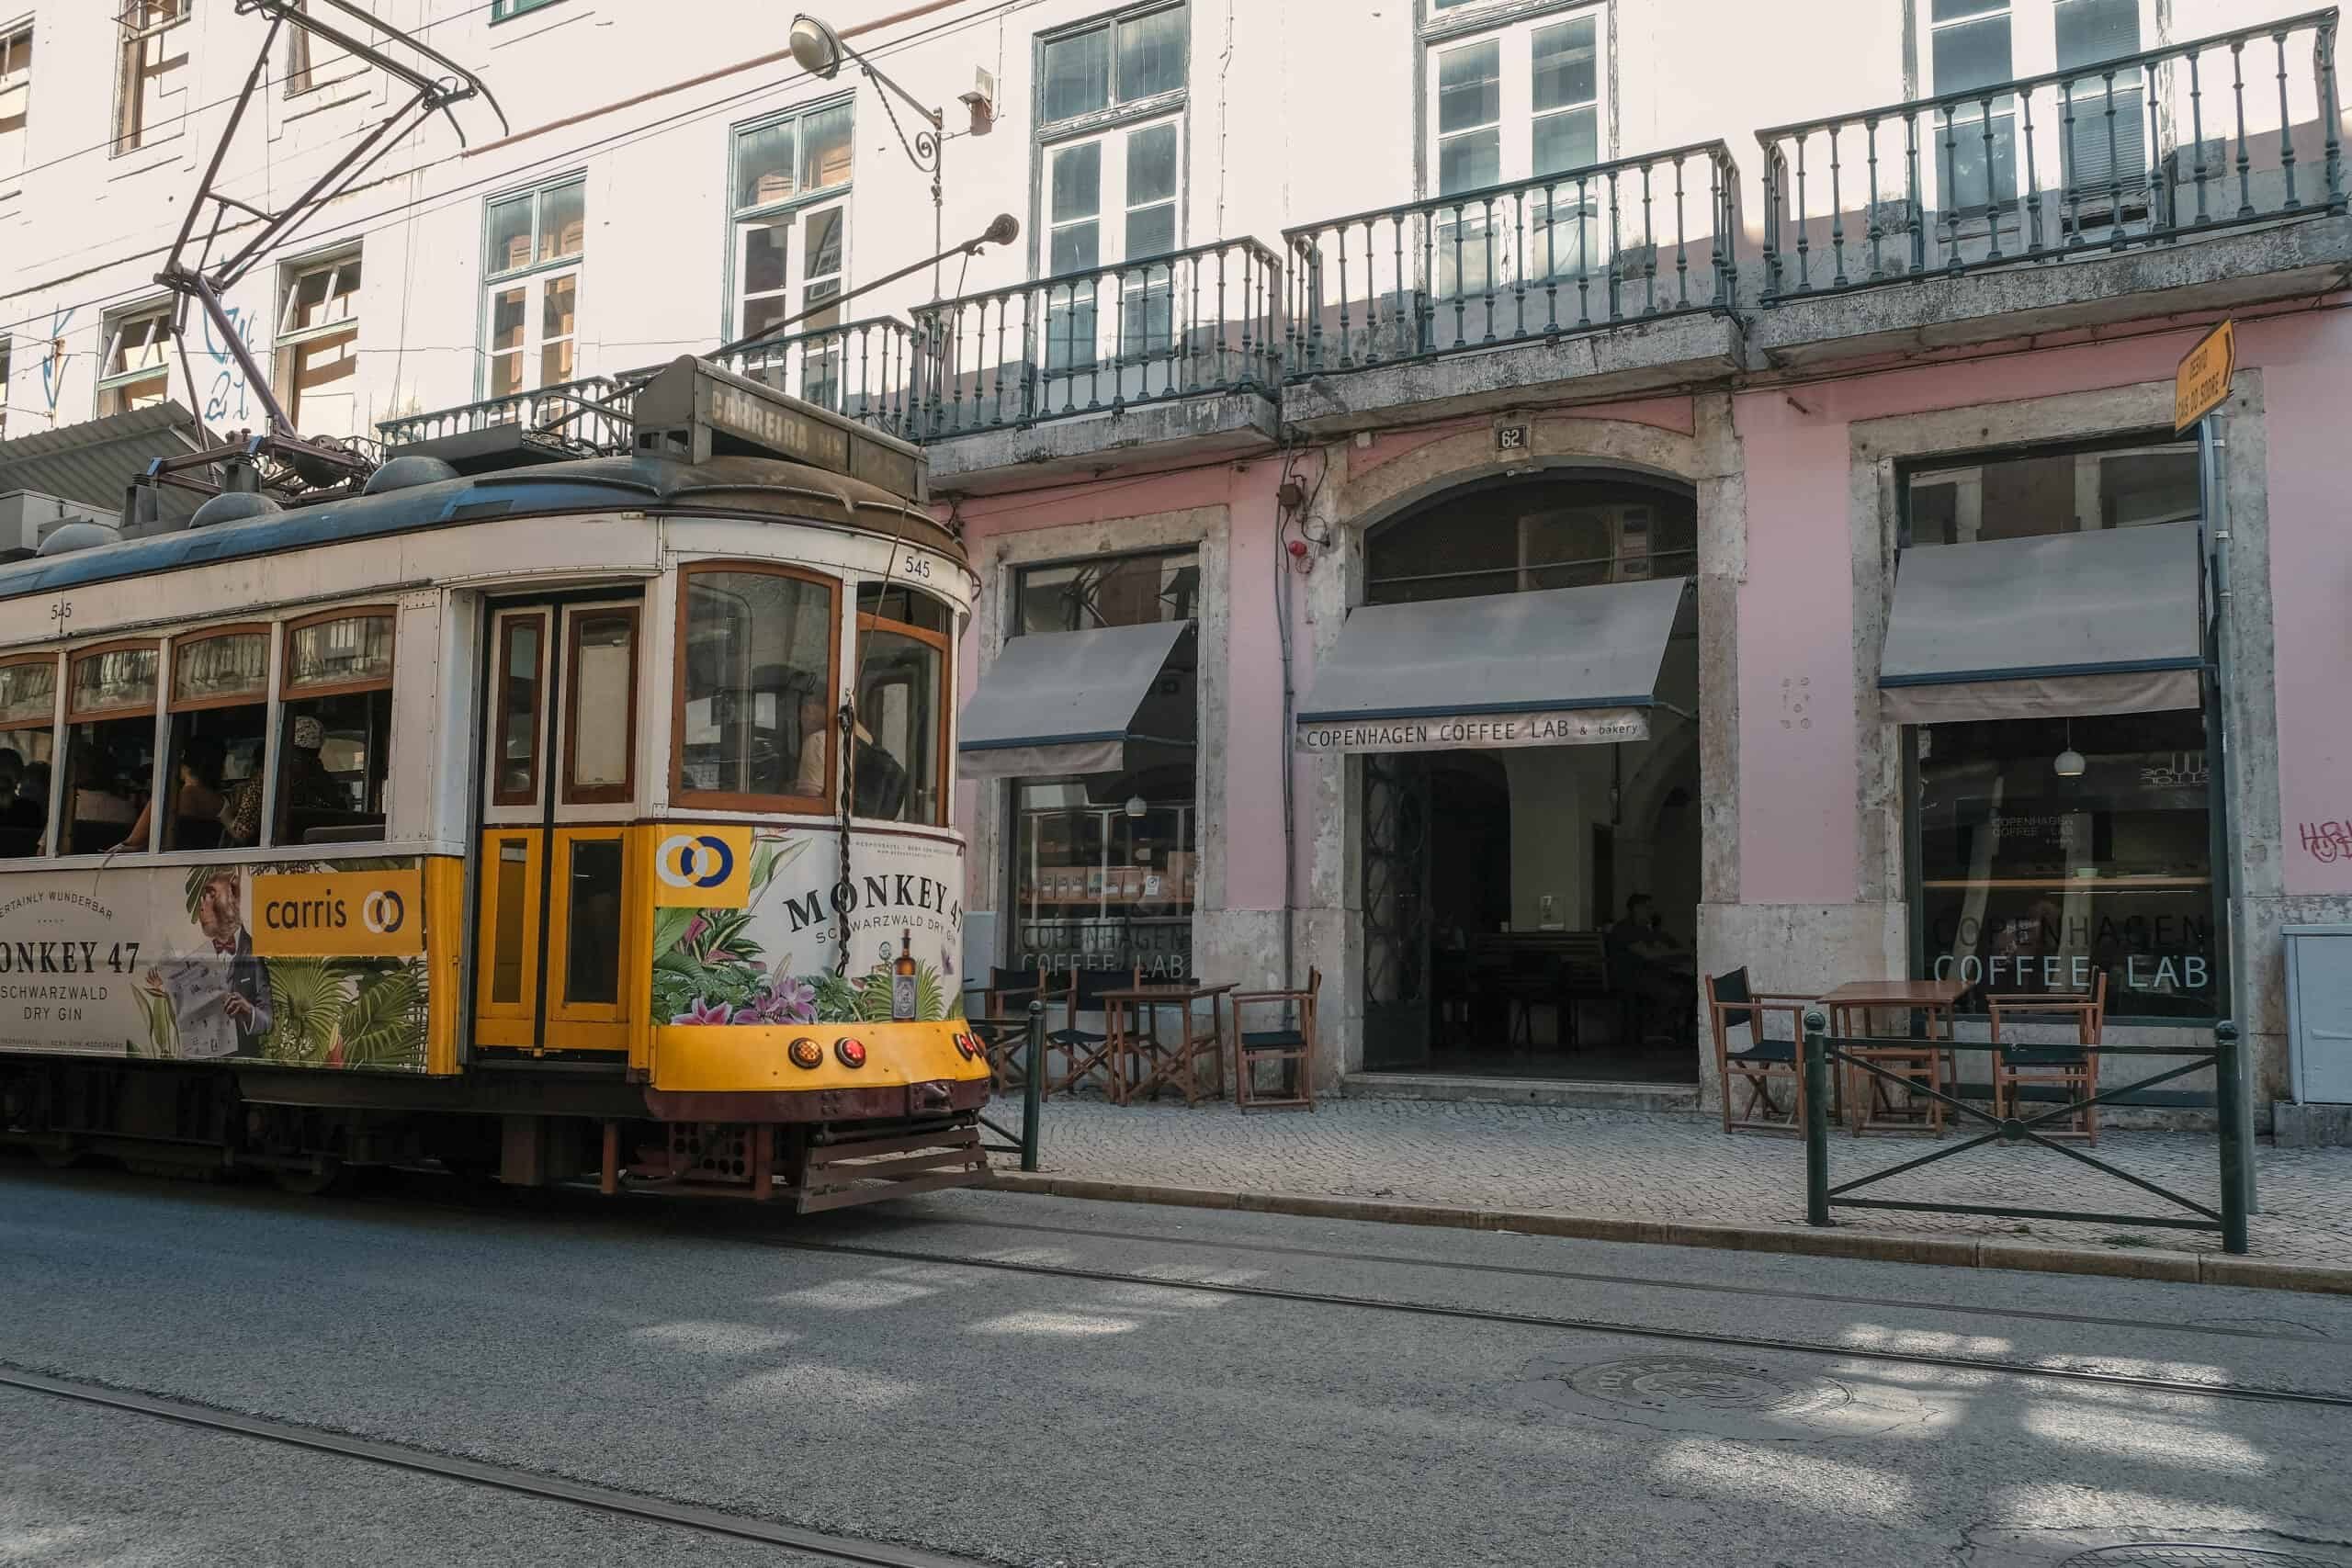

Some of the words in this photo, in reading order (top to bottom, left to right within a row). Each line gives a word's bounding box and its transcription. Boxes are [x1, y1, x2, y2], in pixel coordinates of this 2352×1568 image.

[712, 390, 808, 452] CARREIRA
[1502, 429, 1520, 448] 62
[905, 555, 930, 579] 545
[51, 602, 72, 620] 545
[1306, 725, 1428, 748] COPENHAGEN
[1440, 722, 1516, 742] COFFEE
[1531, 719, 1568, 739] LAB
[1579, 726, 1588, 736] &
[1599, 723, 1639, 738] bakery
[48, 890, 113, 919] WUNDERBAR
[266, 888, 348, 930] carris
[783, 874, 948, 933] MONKEY
[815, 915, 924, 944] SCWARZWALD
[1933, 914, 2205, 947] COPENHAGEN
[107, 942, 141, 974] 47
[1136, 954, 1184, 979] LAB
[1933, 954, 2090, 987] COFFEE
[2127, 955, 2209, 988] LAB
[0, 985, 108, 1000] SCHWARZWALD
[23, 1007, 51, 1021] DRY
[58, 1007, 83, 1021] GIN
